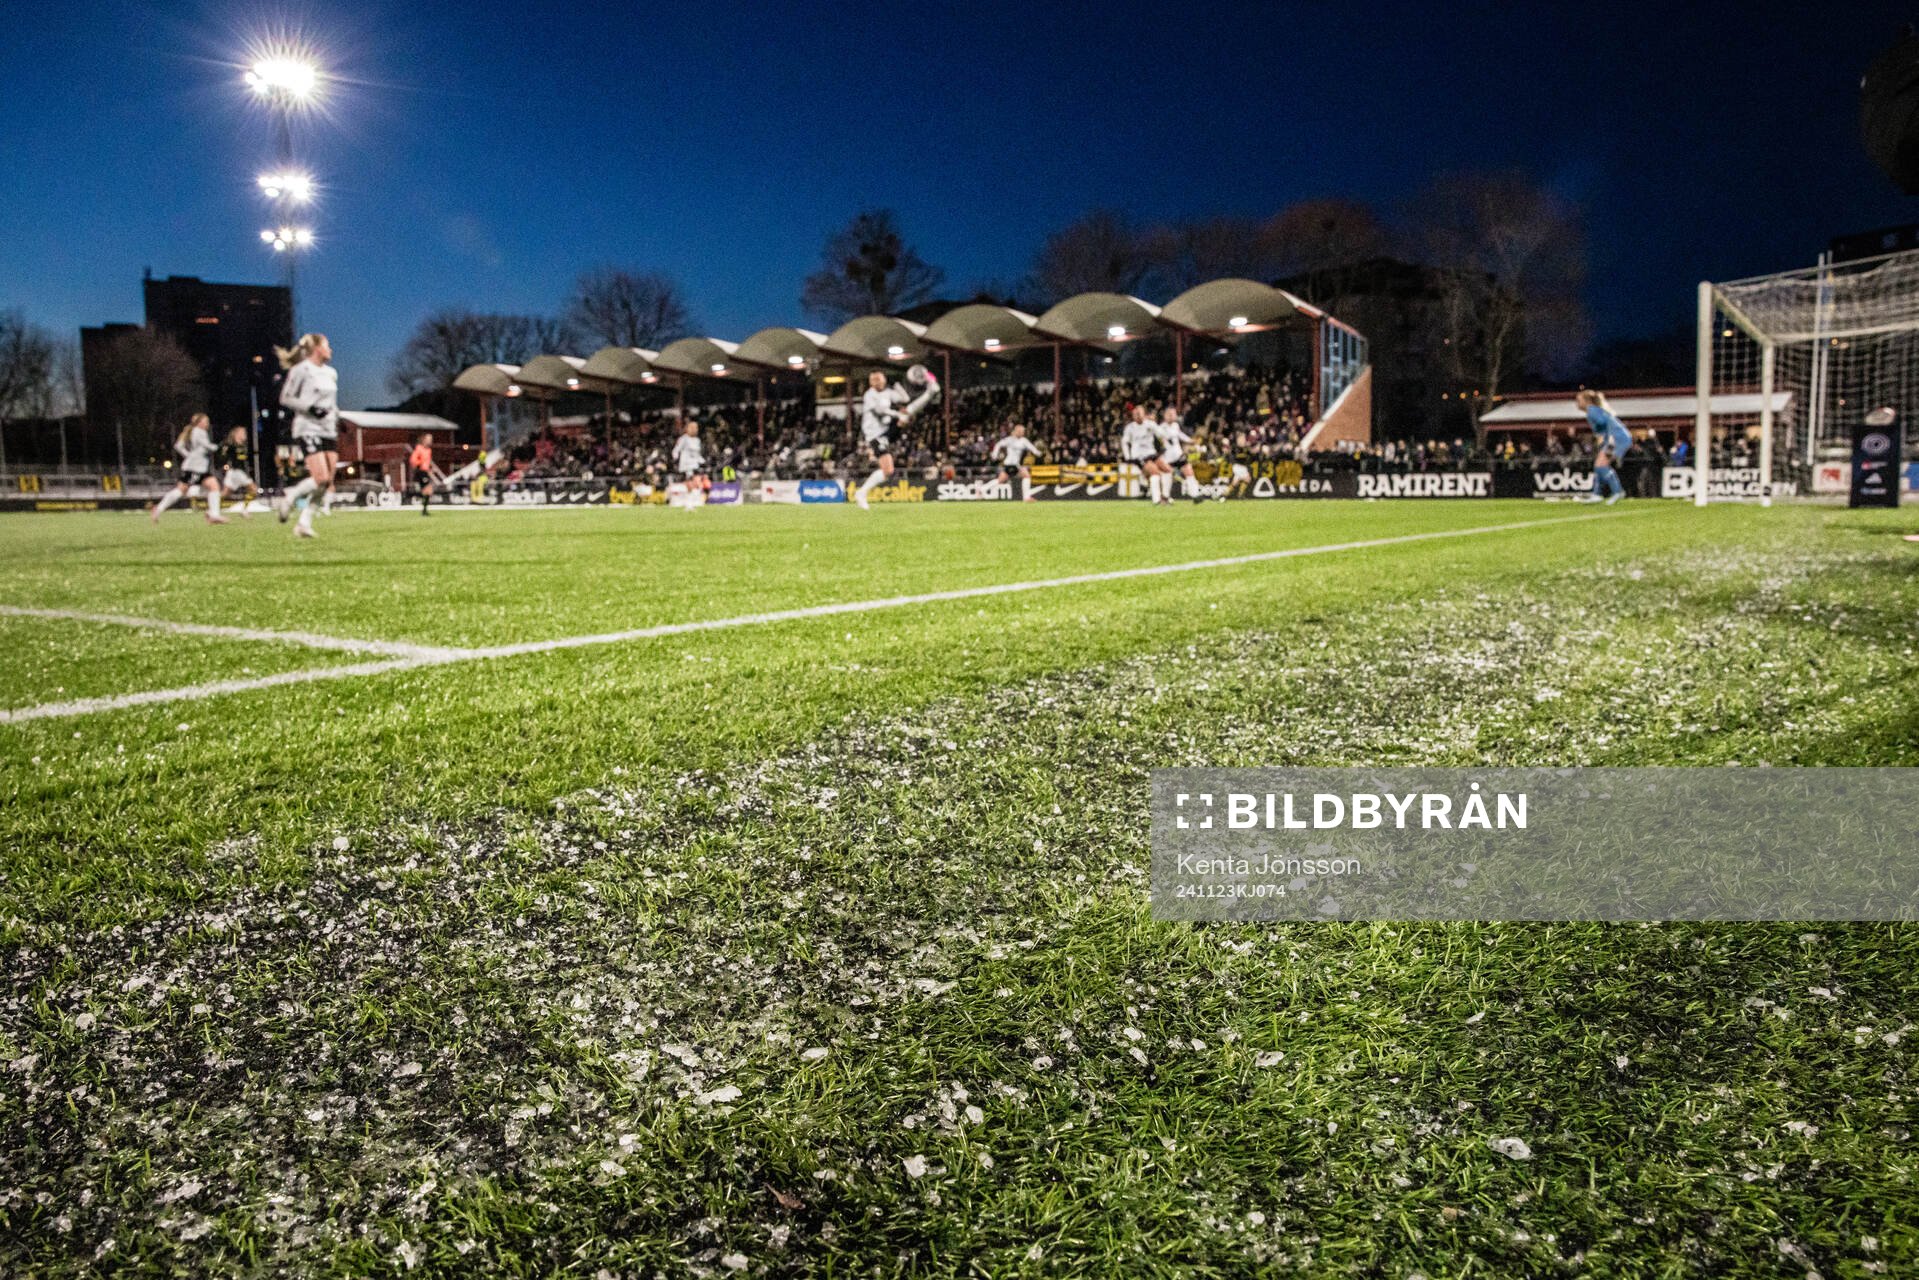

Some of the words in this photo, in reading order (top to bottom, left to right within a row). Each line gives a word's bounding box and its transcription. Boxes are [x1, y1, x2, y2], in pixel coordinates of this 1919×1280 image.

[1357, 473, 1492, 497] RAMIRENT
[1534, 467, 1597, 491] voky
[1705, 482, 1797, 496] DAHLGEN
[847, 480, 927, 501] tecaller
[937, 480, 1013, 500] stadm
